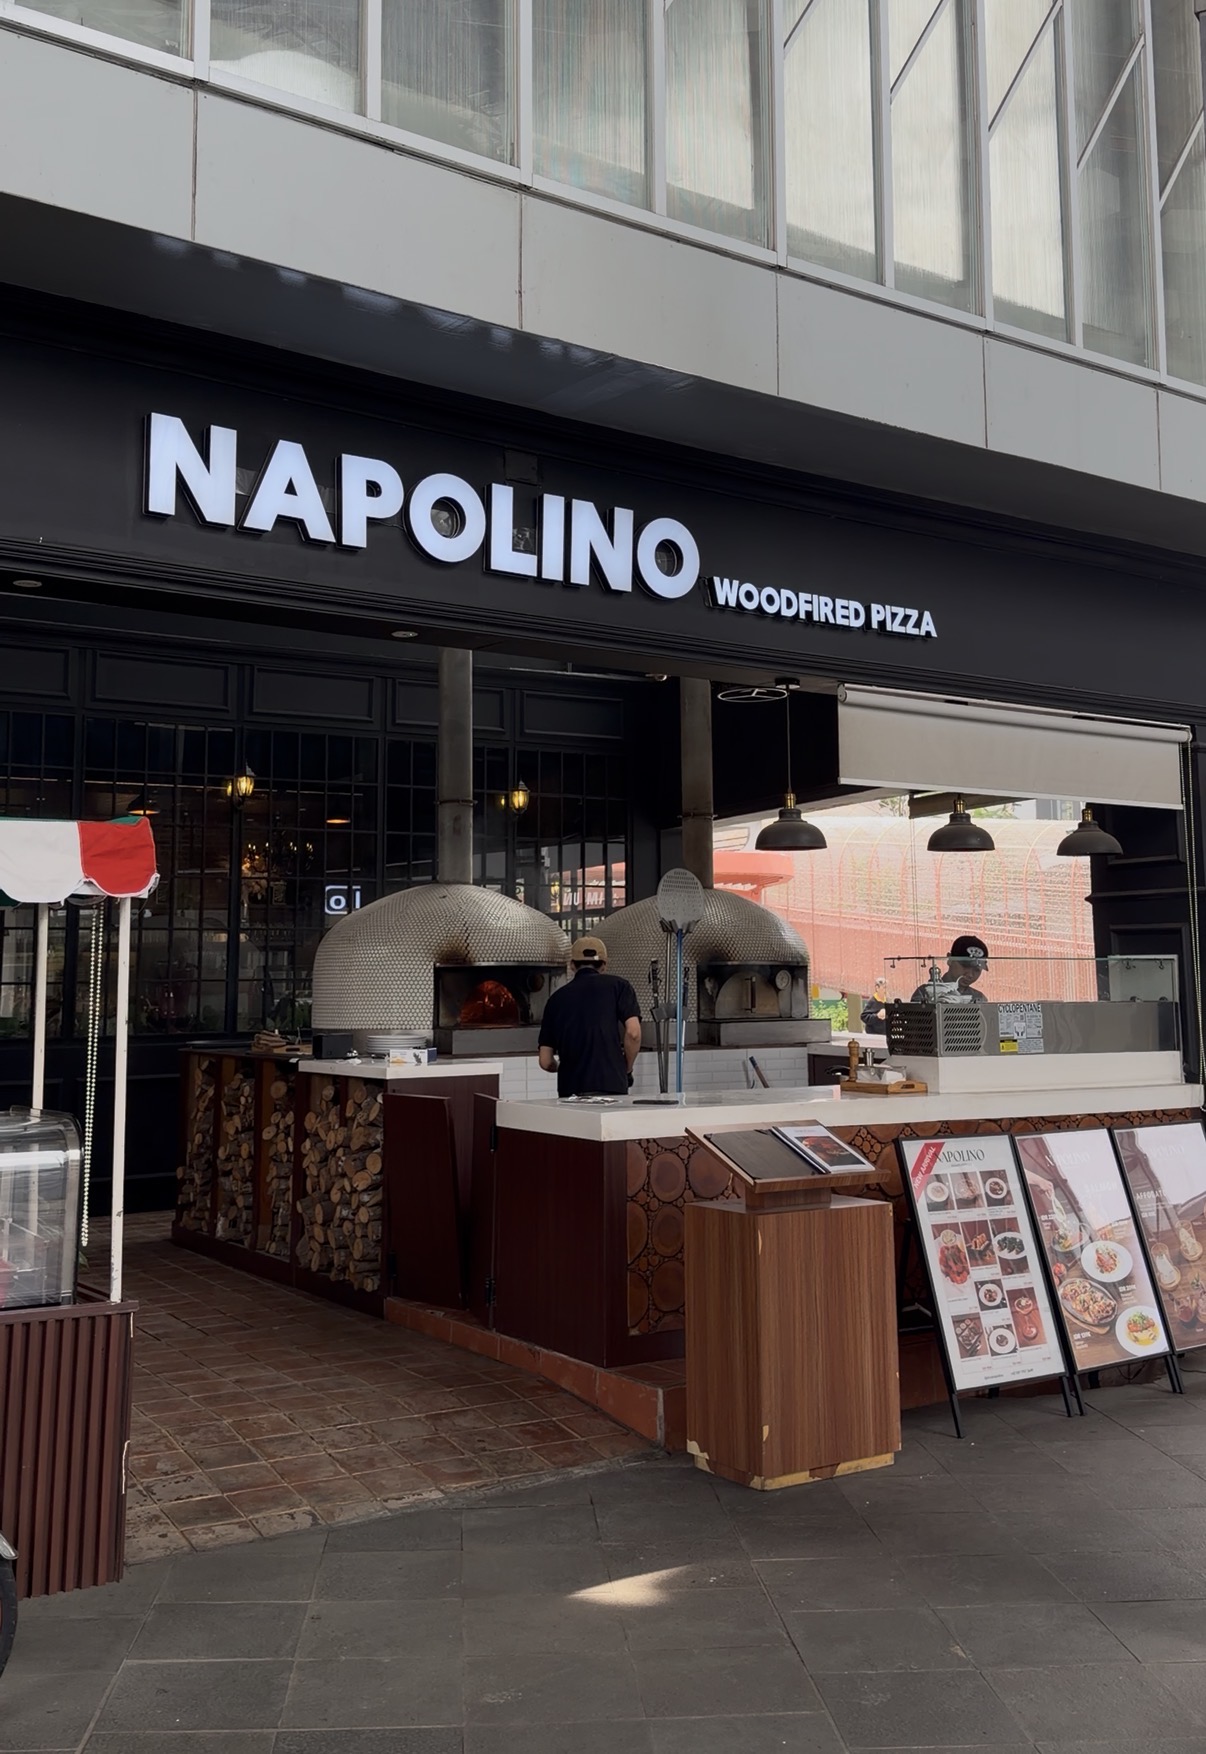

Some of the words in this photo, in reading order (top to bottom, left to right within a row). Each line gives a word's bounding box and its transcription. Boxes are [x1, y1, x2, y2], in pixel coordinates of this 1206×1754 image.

[145, 412, 700, 600] NAPOLINO
[713, 576, 865, 630] WOODFIRED
[870, 603, 938, 639] PIZZA
[998, 1003, 1041, 1013] CYCLOPENTANE
[913, 1171, 925, 1189] NEW
[919, 1146, 937, 1176] ARRIVAL
[934, 1149, 985, 1164] NAPOLINO
